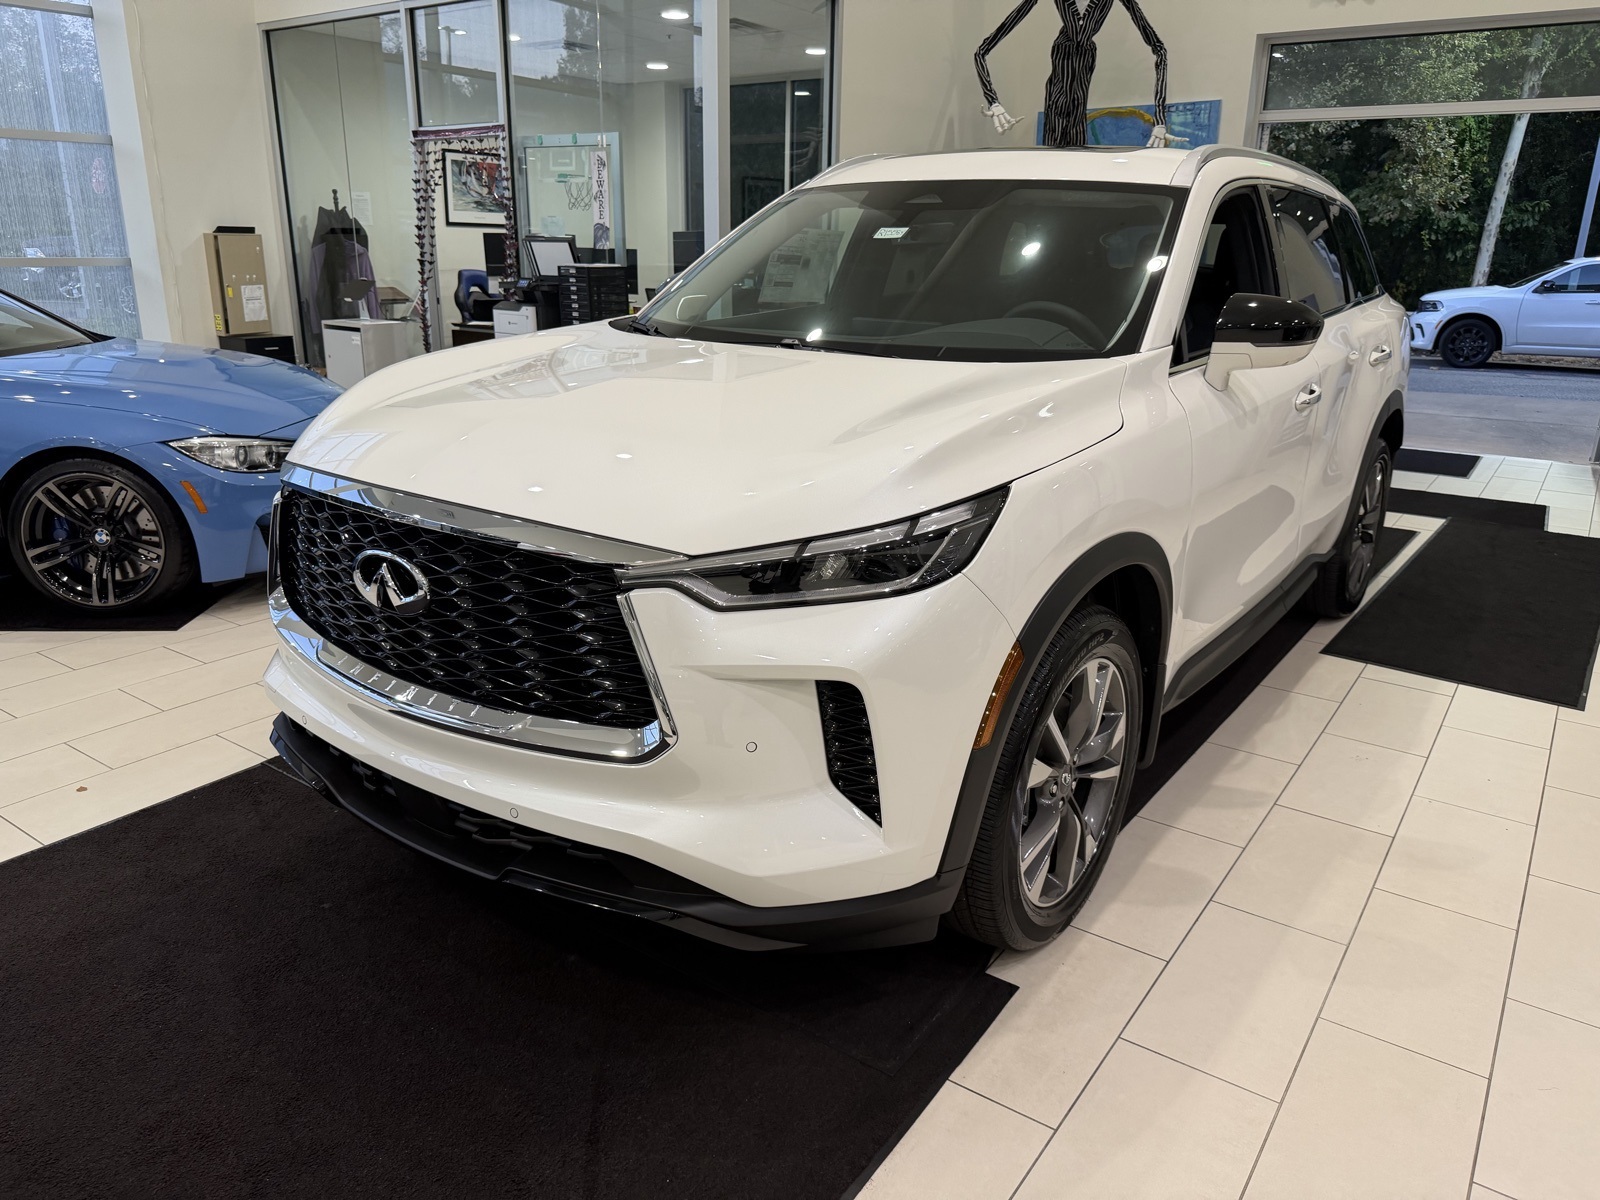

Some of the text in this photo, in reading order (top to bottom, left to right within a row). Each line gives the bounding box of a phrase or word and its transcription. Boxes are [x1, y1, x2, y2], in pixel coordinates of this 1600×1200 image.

[595, 158, 606, 220] BEWARE
[214, 313, 223, 331] PER
[1088, 632, 1105, 650] HP2
[337, 655, 482, 718] INFINITI
